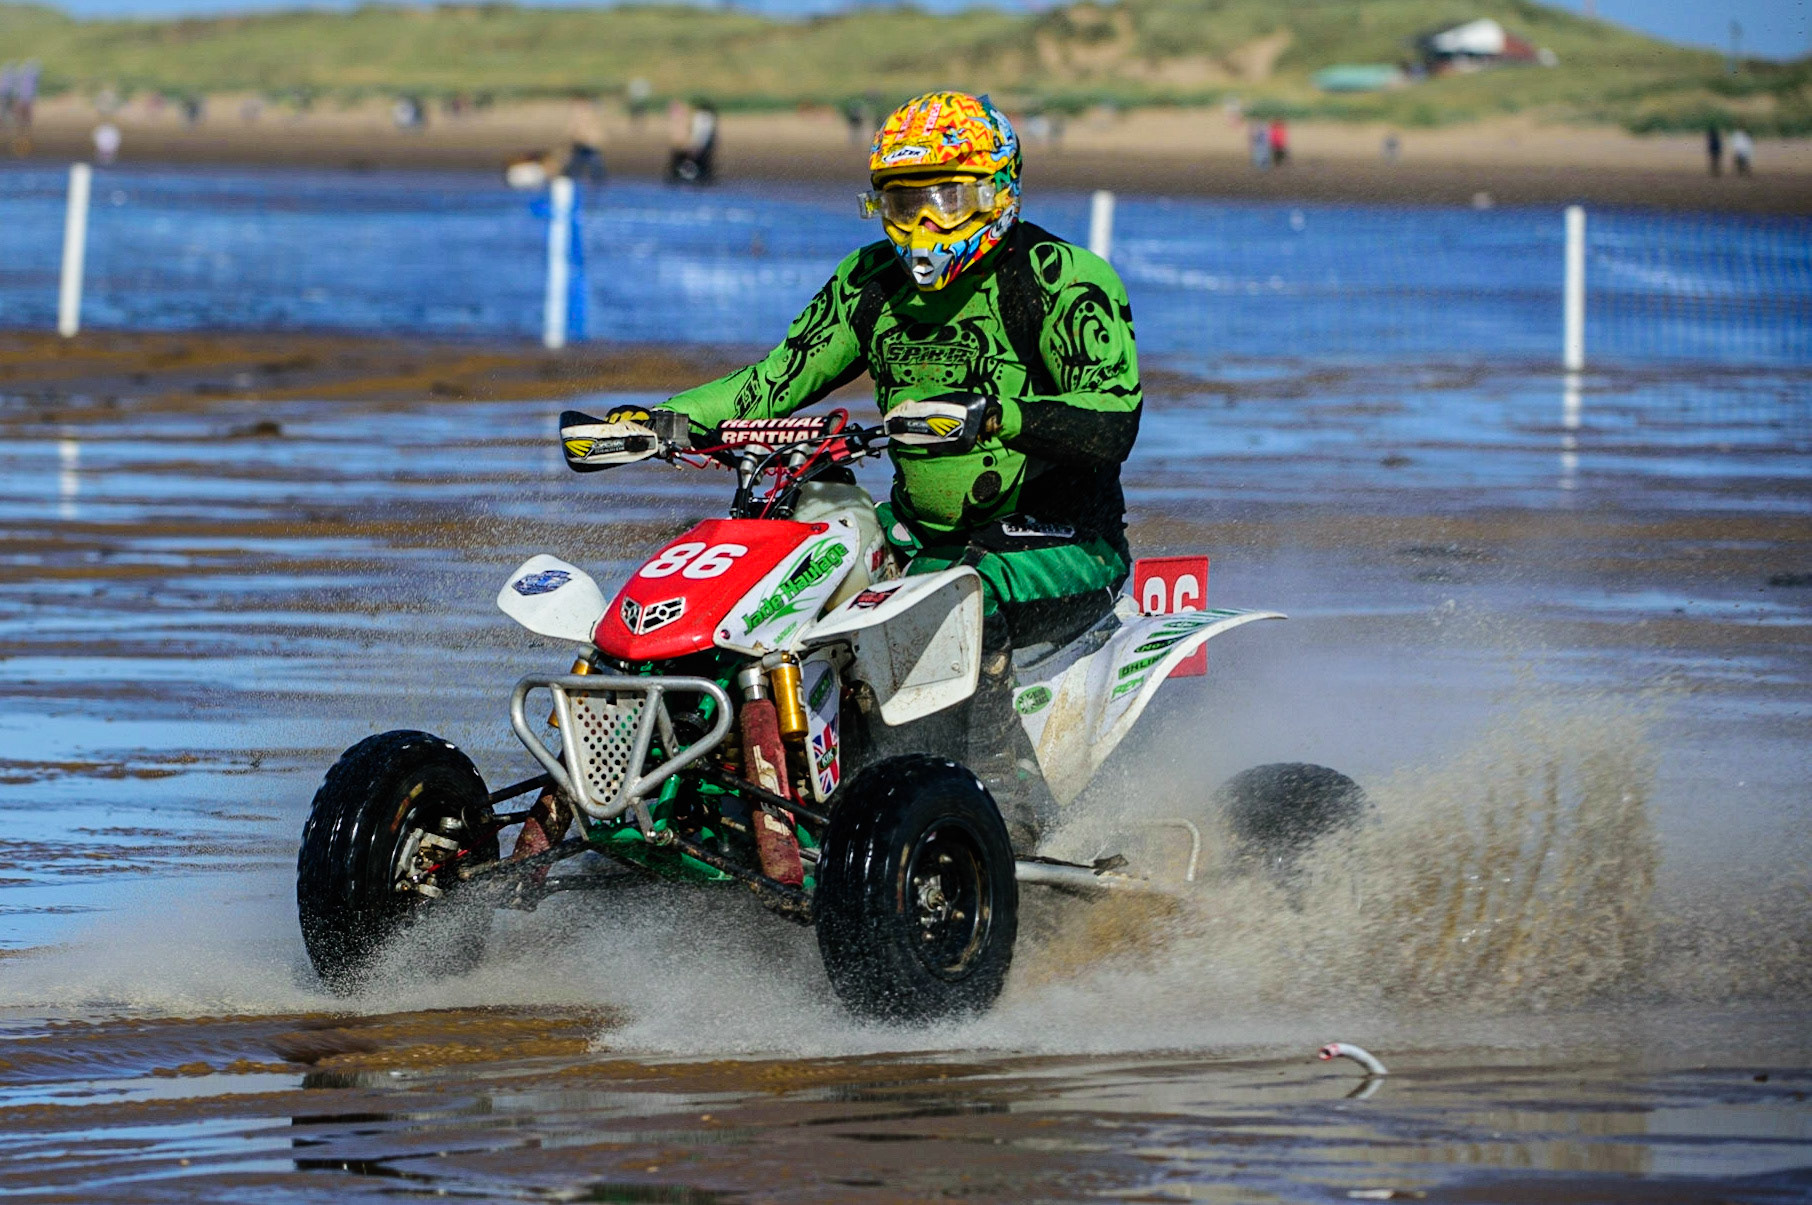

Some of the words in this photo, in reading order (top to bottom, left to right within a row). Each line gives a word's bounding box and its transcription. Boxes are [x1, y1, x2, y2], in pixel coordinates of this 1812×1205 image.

[720, 416, 825, 429] RENTHAL
[638, 541, 749, 580] 86
[743, 594, 785, 636] Jade
[778, 541, 850, 601] Haulage
